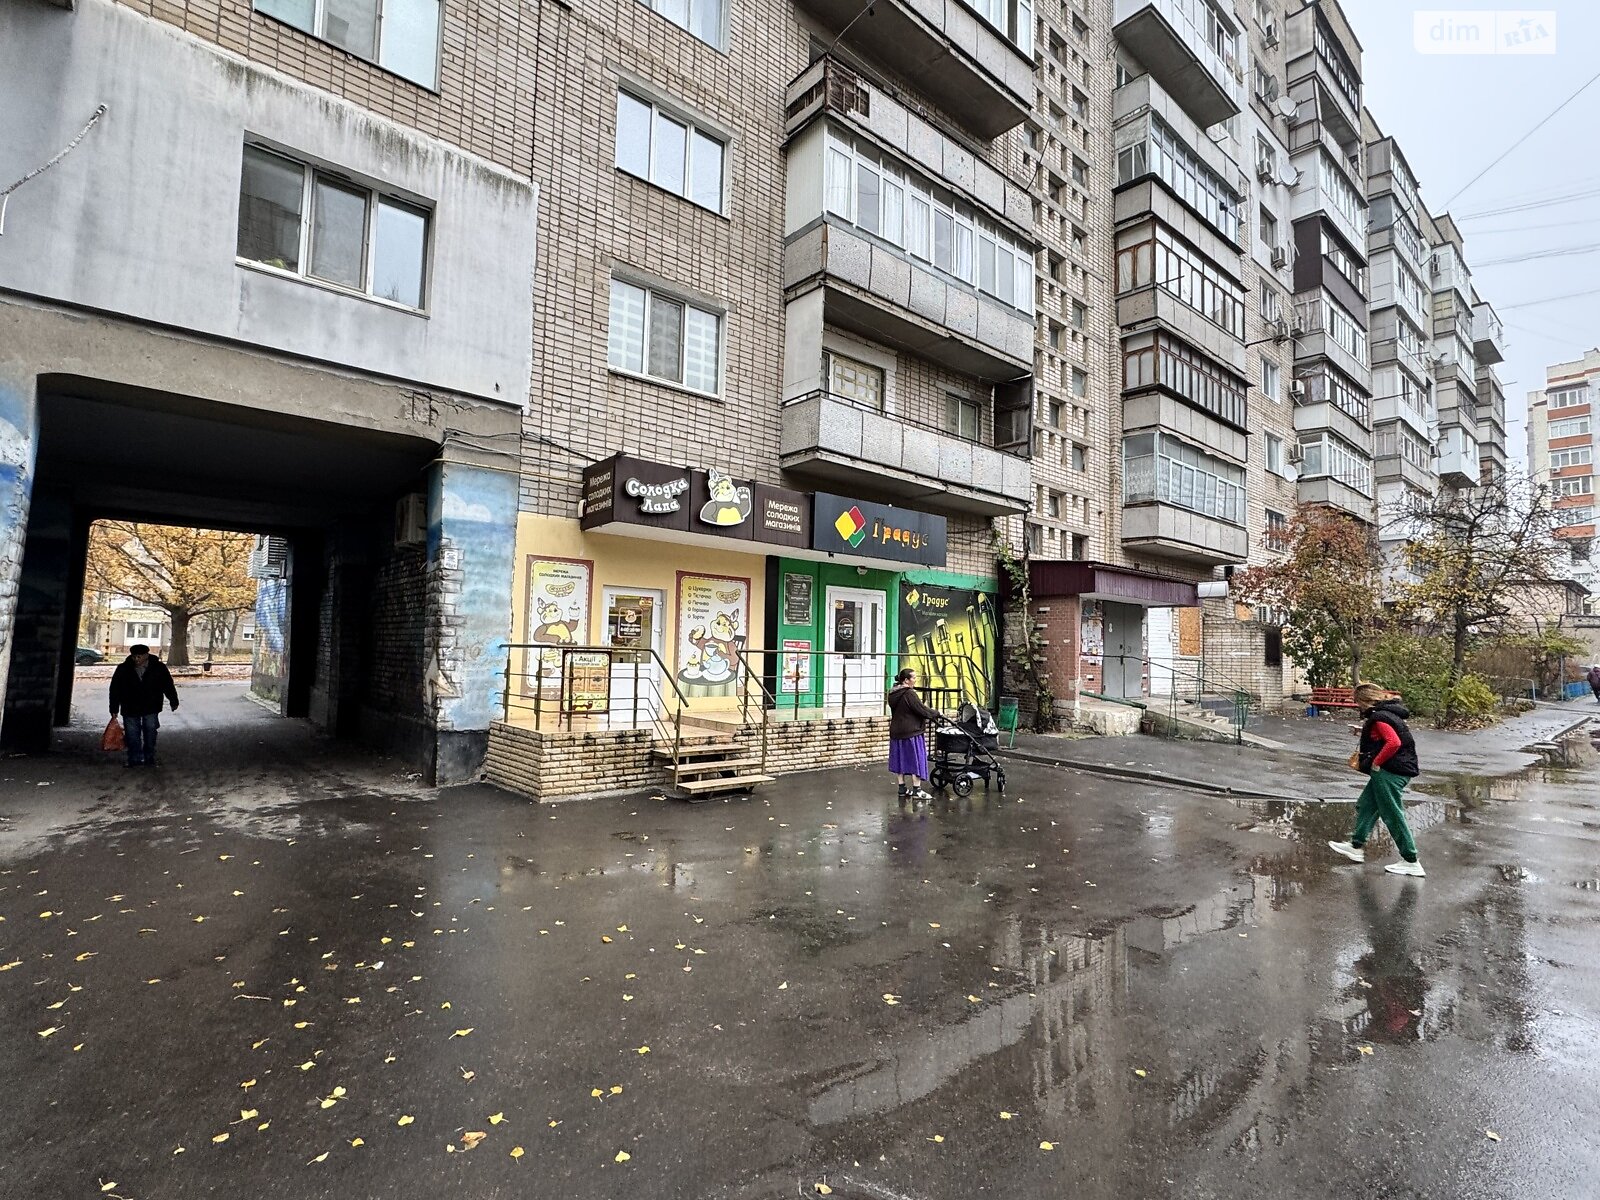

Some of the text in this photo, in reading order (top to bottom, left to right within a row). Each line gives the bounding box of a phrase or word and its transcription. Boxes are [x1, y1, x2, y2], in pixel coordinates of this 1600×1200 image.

[589, 472, 611, 488] Мережа
[588, 486, 612, 502] солодких
[628, 478, 688, 499] Солодка
[586, 498, 612, 514] магазинів
[643, 499, 679, 511] Лапа
[768, 500, 798, 513] Мережа
[766, 510, 800, 523] солодких
[765, 520, 801, 532] магазинів
[872, 517, 929, 549] Градус
[922, 592, 949, 608] Градус
